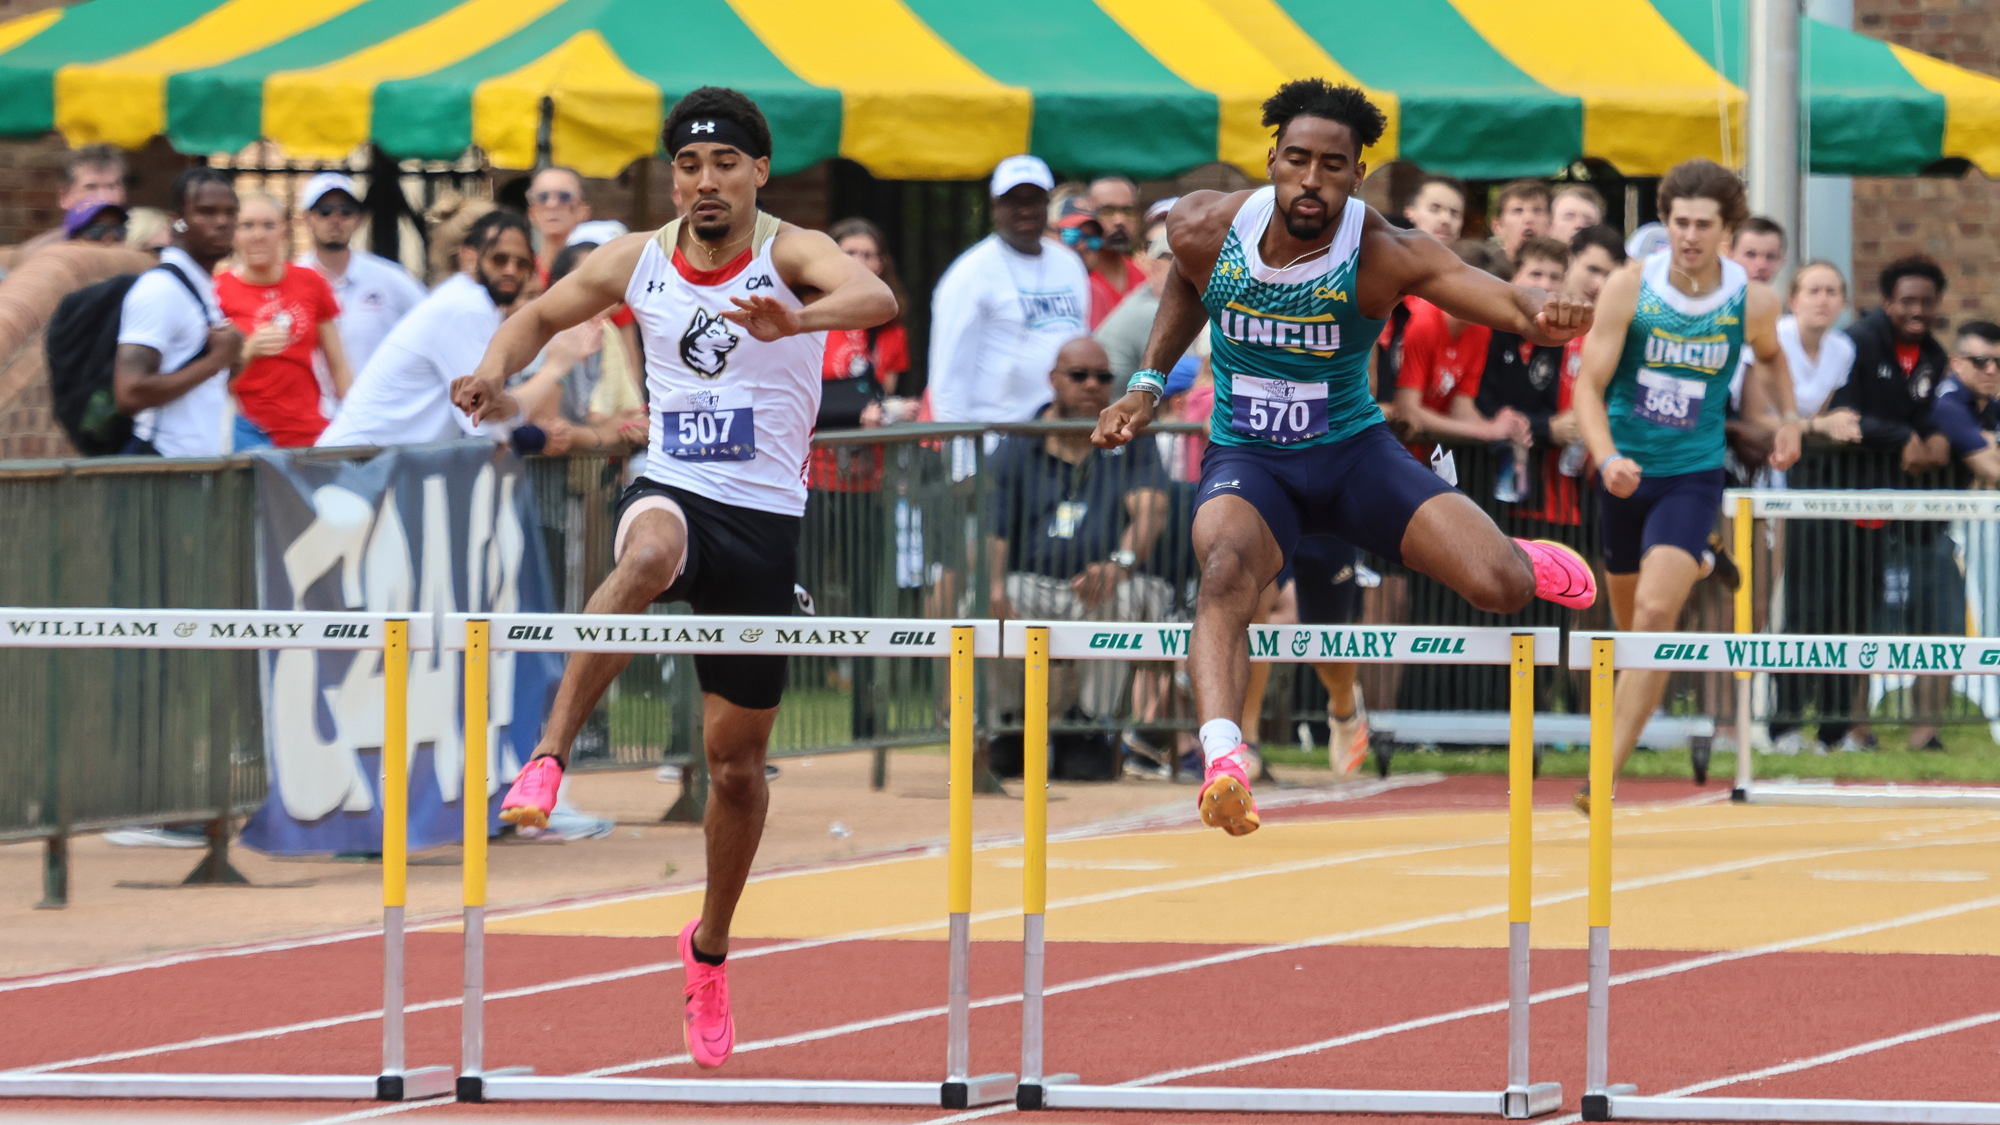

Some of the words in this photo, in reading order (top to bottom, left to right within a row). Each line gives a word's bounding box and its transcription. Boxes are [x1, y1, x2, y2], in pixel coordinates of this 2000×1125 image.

[1314, 287, 1347, 303] CAA
[1221, 309, 1340, 350] UNCW
[1645, 334, 1730, 370] UNCW
[1250, 399, 1309, 432] 570
[1645, 388, 1690, 418] 563
[679, 411, 734, 445] 507
[7, 621, 158, 637] WILLIAM
[174, 623, 198, 638] &
[210, 623, 304, 639] MARY
[323, 624, 370, 639] GILL
[507, 626, 554, 641] GILL
[574, 627, 725, 643] WILLIAM
[739, 628, 764, 643] &
[775, 629, 870, 644] MARY
[889, 631, 936, 645] GILL
[1089, 633, 1143, 650] GILL
[1292, 631, 1311, 657] &
[1320, 631, 1397, 658] MARY
[1410, 637, 1466, 654] GILL
[1654, 643, 1709, 660] GILL
[1724, 640, 1848, 668] WILLIAM
[1859, 642, 1878, 669] &
[1888, 643, 1966, 670] MARY
